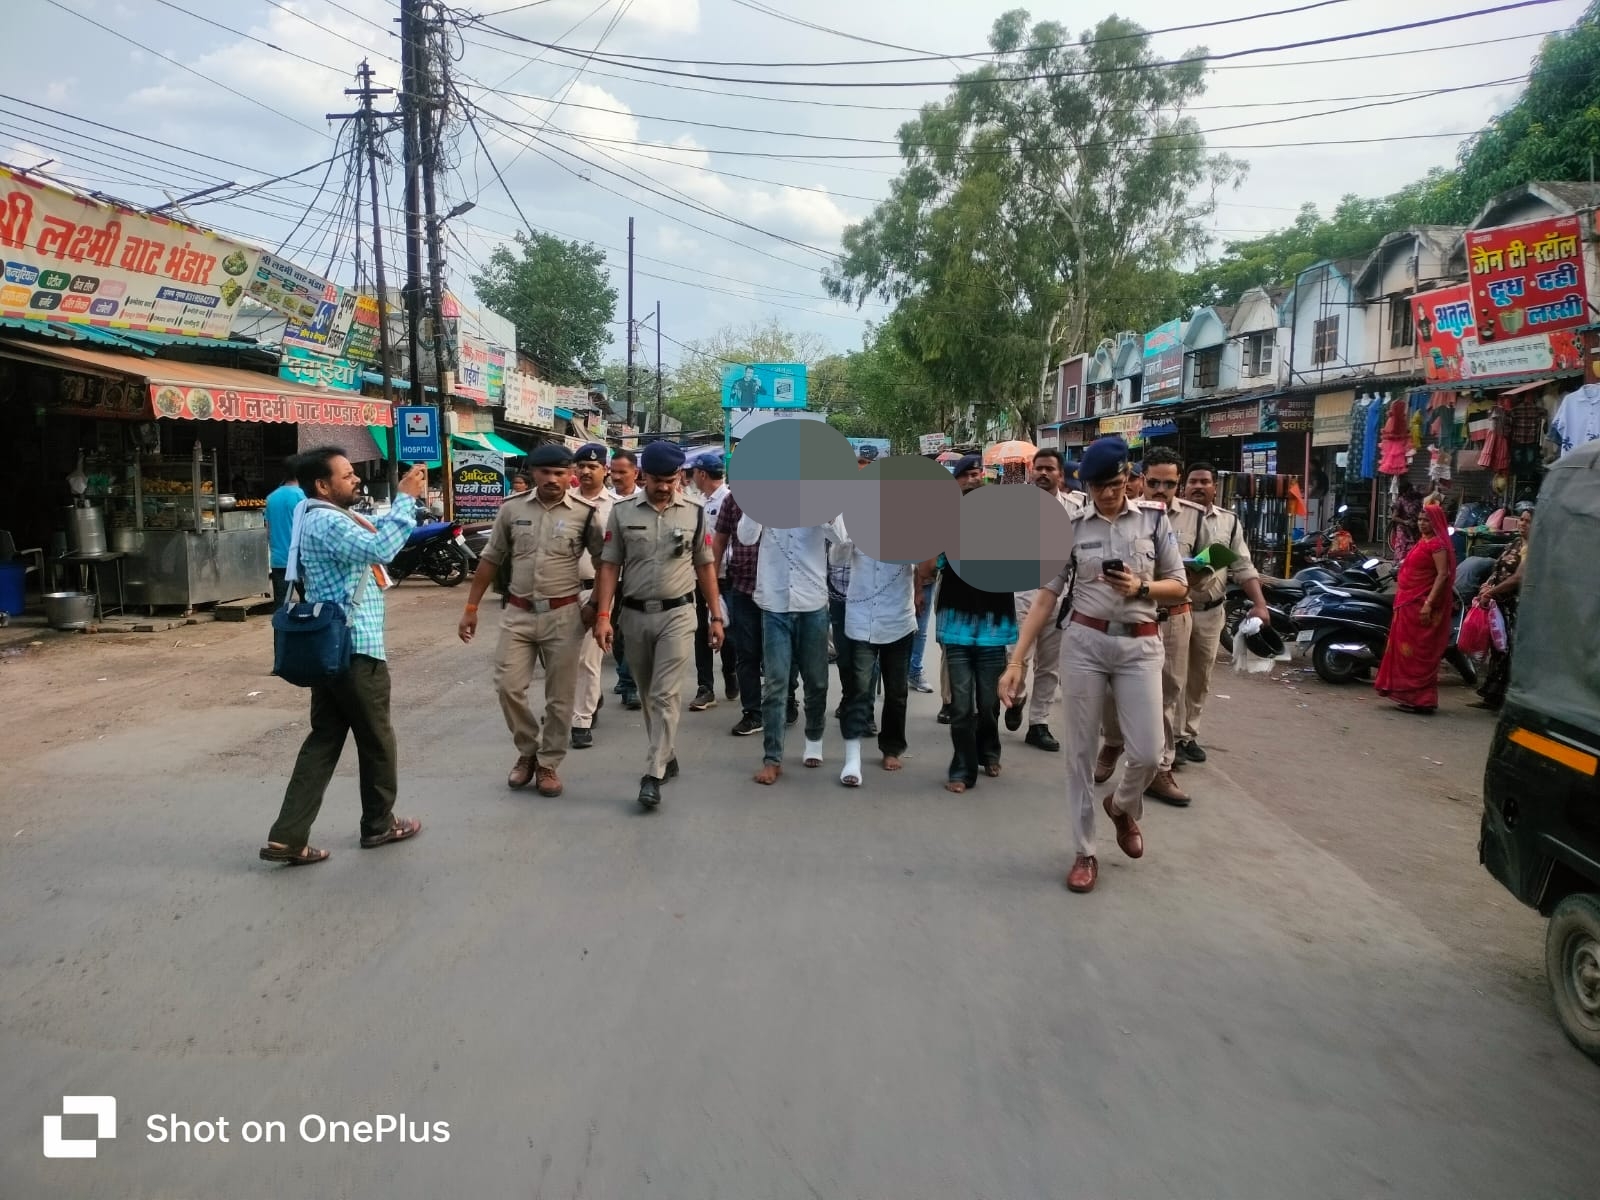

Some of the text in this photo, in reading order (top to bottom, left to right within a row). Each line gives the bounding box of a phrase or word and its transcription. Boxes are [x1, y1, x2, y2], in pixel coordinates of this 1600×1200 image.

[36, 214, 122, 268] लक्ष्मी
[120, 236, 166, 276] चाट
[164, 242, 217, 286] भंडार
[1471, 246, 1504, 274] जैन
[1487, 263, 1578, 307] दूध दही
[1433, 301, 1474, 338] अतुल
[1526, 294, 1583, 325] लस्सी
[217, 391, 361, 424] श्री लक्ष्मी चाट भण्डार
[402, 446, 436, 454] HOSPITAL
[455, 482, 503, 494] चश्मे वाले
